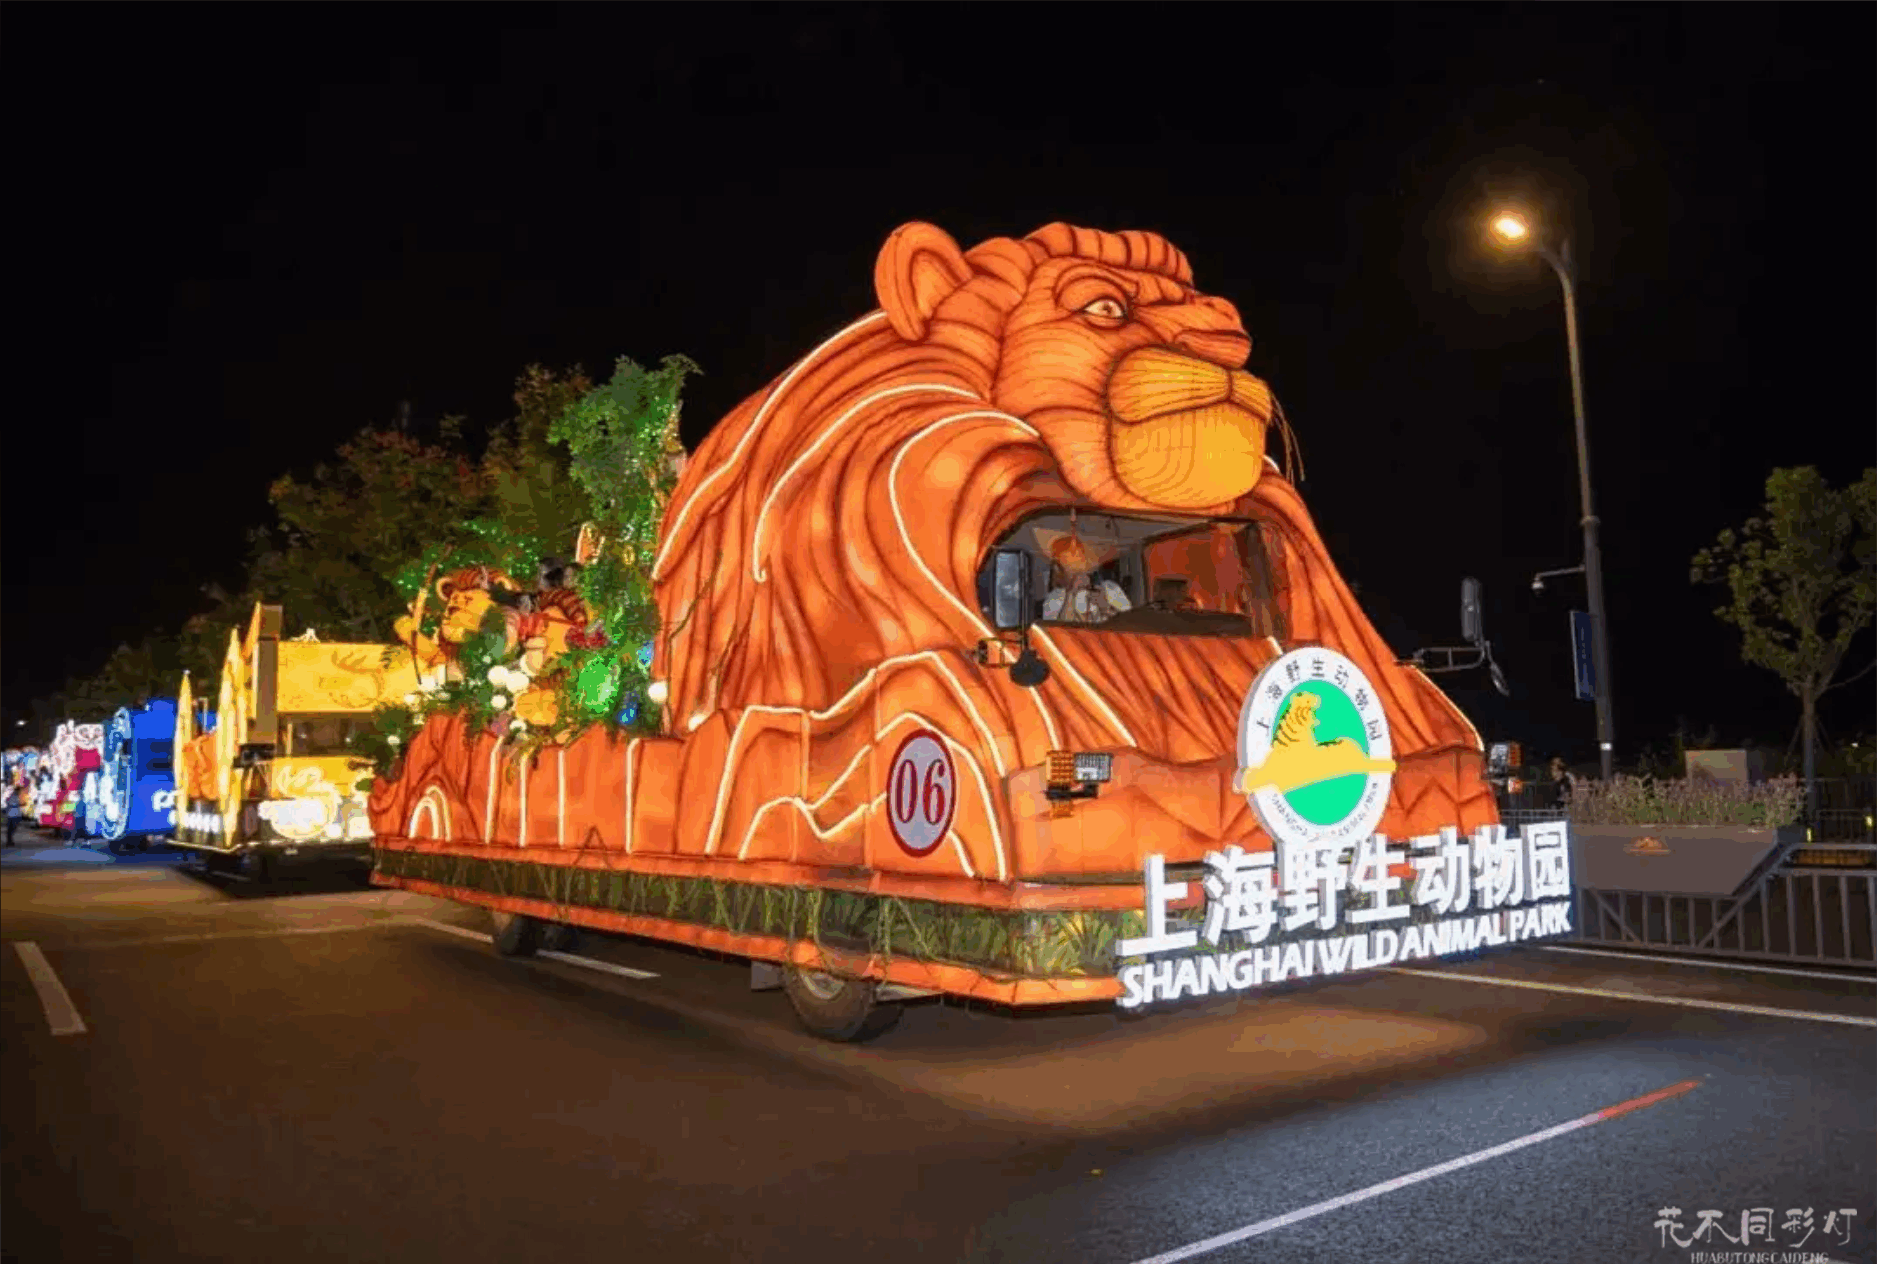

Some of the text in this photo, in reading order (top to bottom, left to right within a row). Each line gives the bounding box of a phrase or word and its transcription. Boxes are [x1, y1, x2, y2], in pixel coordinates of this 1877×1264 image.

[895, 758, 945, 826] 06
[1115, 820, 1571, 957] 上海野生动物园
[1118, 901, 1571, 1009] SHANGHAI WILD ANIMAL PARK
